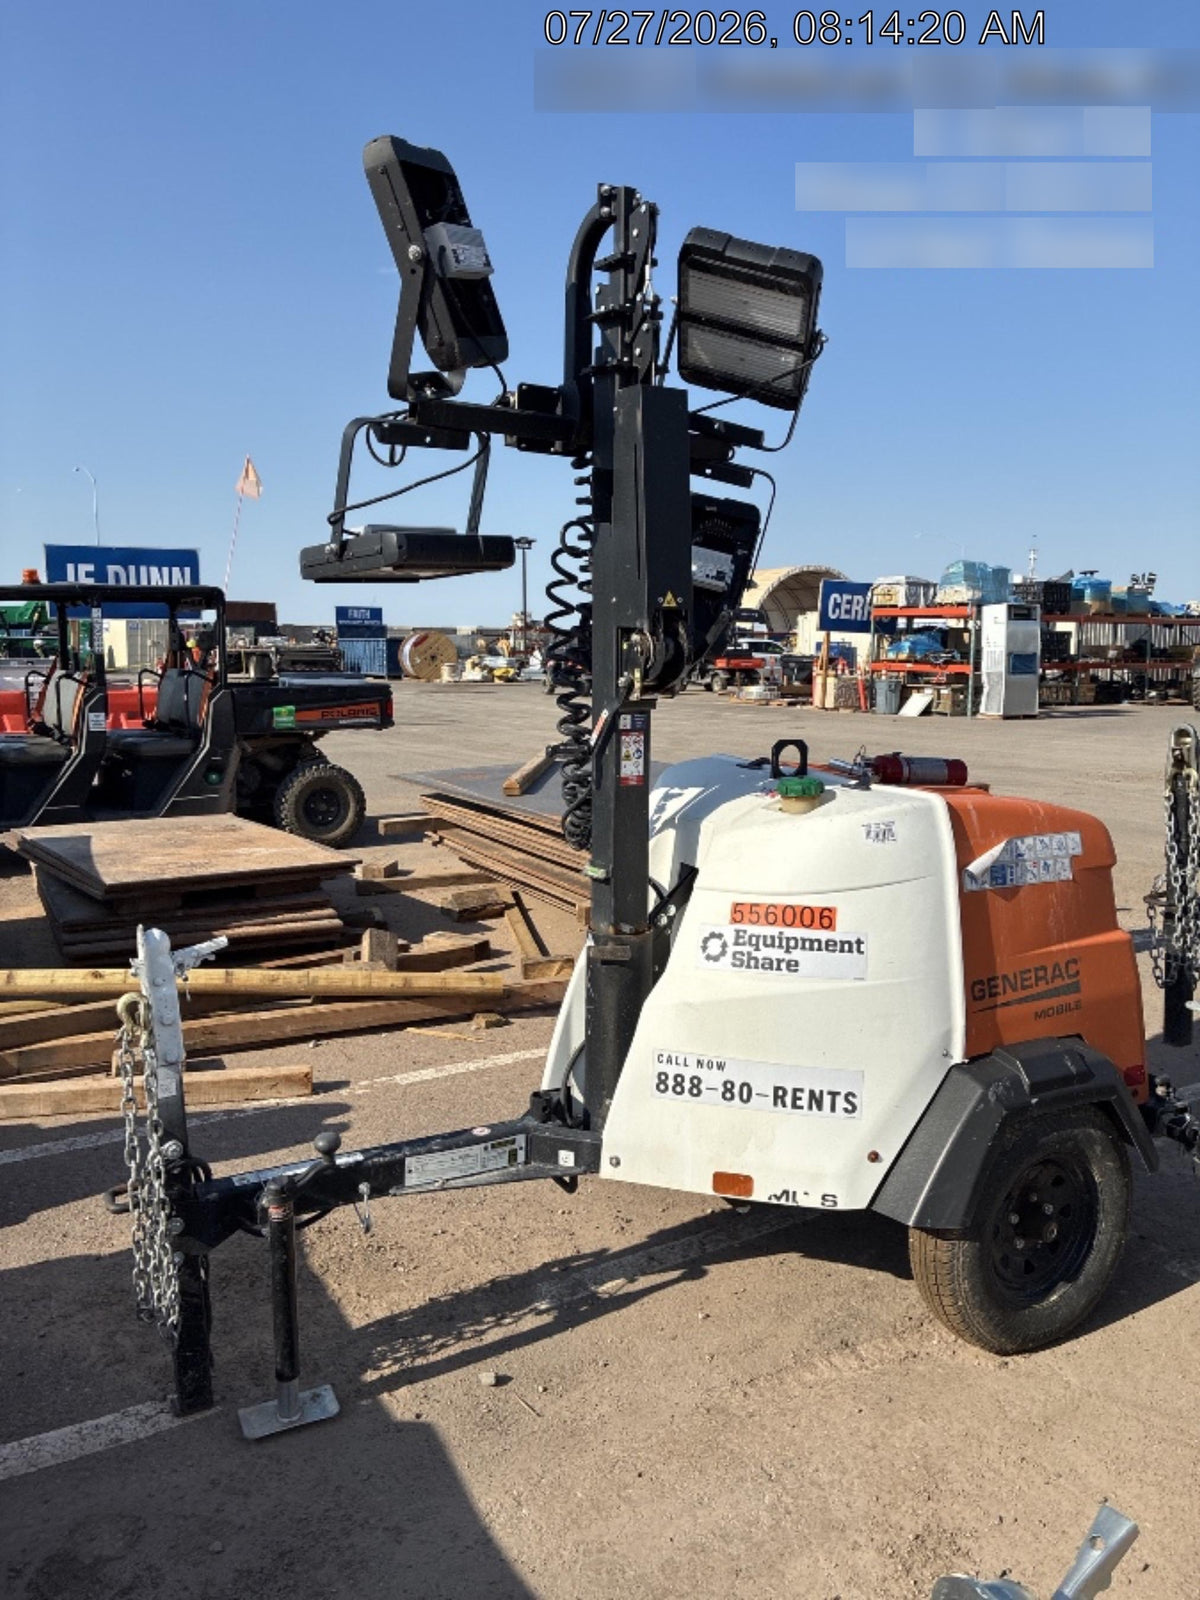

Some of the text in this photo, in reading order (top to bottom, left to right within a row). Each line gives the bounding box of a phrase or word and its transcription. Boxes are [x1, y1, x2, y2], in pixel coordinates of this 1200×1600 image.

[731, 902, 834, 930] 556006
[733, 928, 865, 955] Equipment
[731, 950, 799, 973] Share
[970, 957, 1080, 1001] GENERAC
[1034, 1000, 1082, 1021] MOBILE
[656, 1053, 727, 1072] CALL NOW
[655, 1071, 858, 1115] 888-80-RENTS
